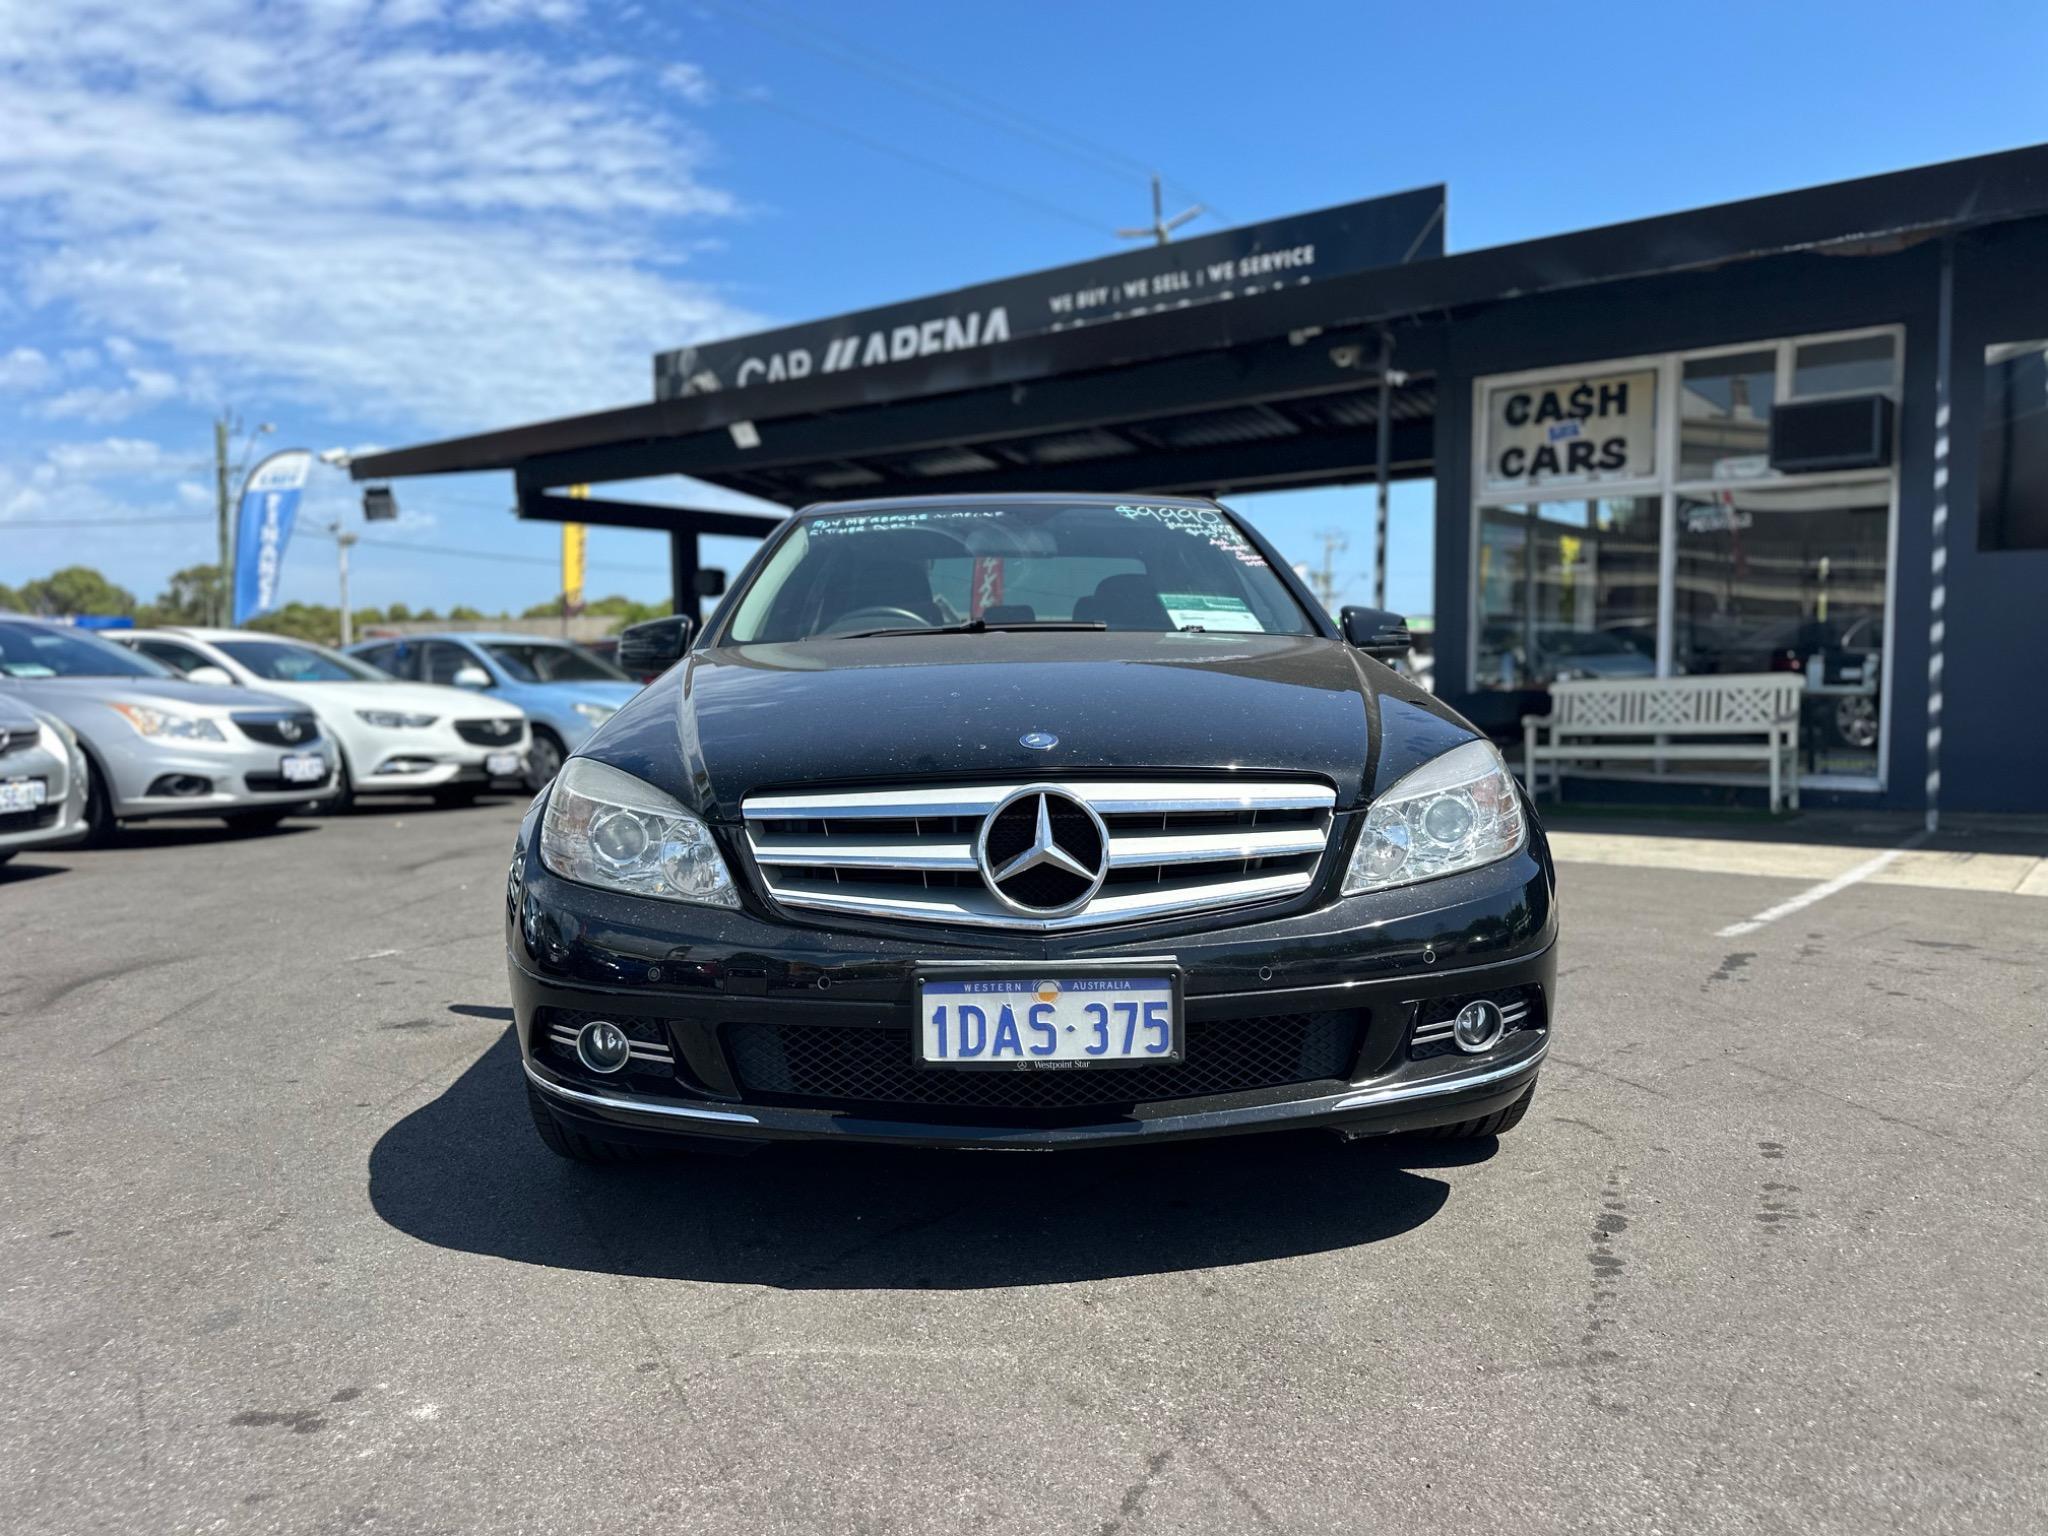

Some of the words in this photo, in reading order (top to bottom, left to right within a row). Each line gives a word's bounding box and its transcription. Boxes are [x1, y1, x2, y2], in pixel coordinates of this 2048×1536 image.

[1049, 293, 1073, 313] WE
[1076, 287, 1108, 309] BUY
[1123, 278, 1148, 299] WE
[1152, 271, 1191, 295] SELL
[1207, 261, 1236, 282] WE
[1238, 245, 1315, 278] SERVICE
[1500, 437, 1627, 478] CARS
[1115, 505, 1221, 524] $9990
[964, 983, 1022, 993] WESTERN
[1072, 981, 1132, 991] AUSTRALIA
[1034, 1060, 1073, 1070] Westpoint
[1075, 1060, 1091, 1069] Star
